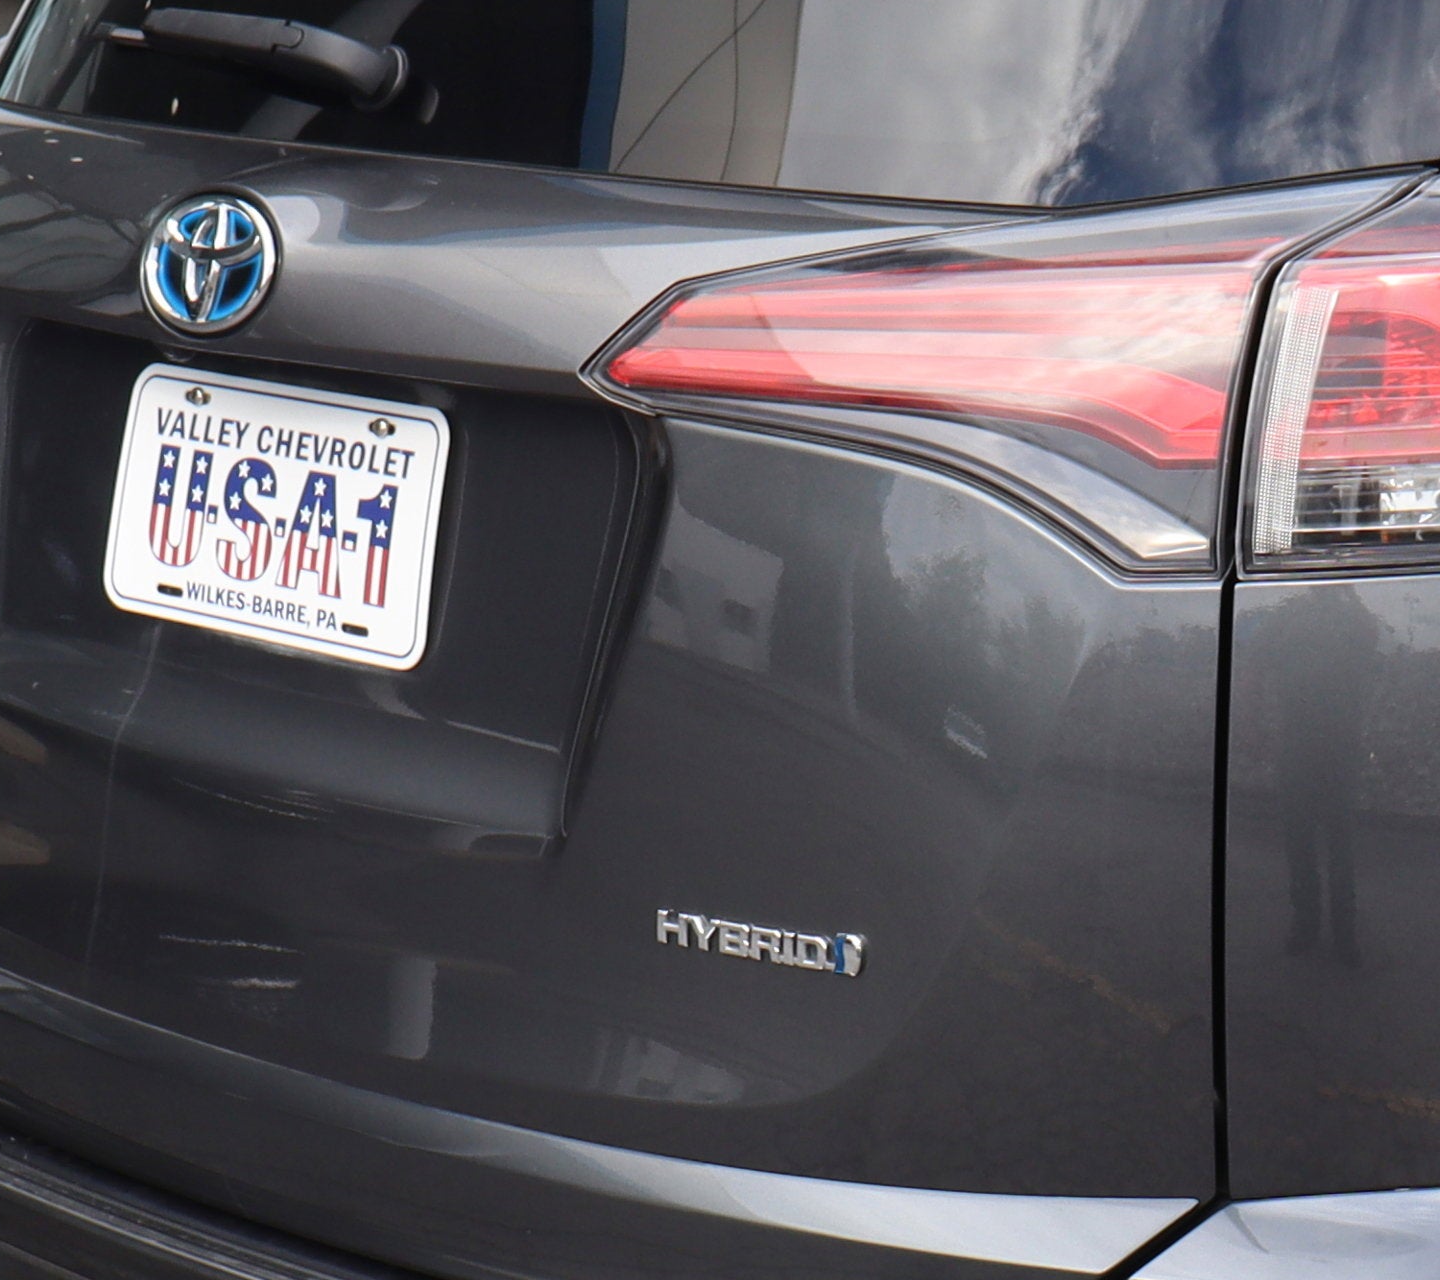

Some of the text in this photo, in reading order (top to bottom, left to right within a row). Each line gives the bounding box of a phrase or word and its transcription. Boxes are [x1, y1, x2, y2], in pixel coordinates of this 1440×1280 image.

[156, 407, 416, 480] VALLEY CHEVROLET
[186, 580, 338, 631] WILKES-BARRE, PA
[657, 909, 828, 971] HYBRID
